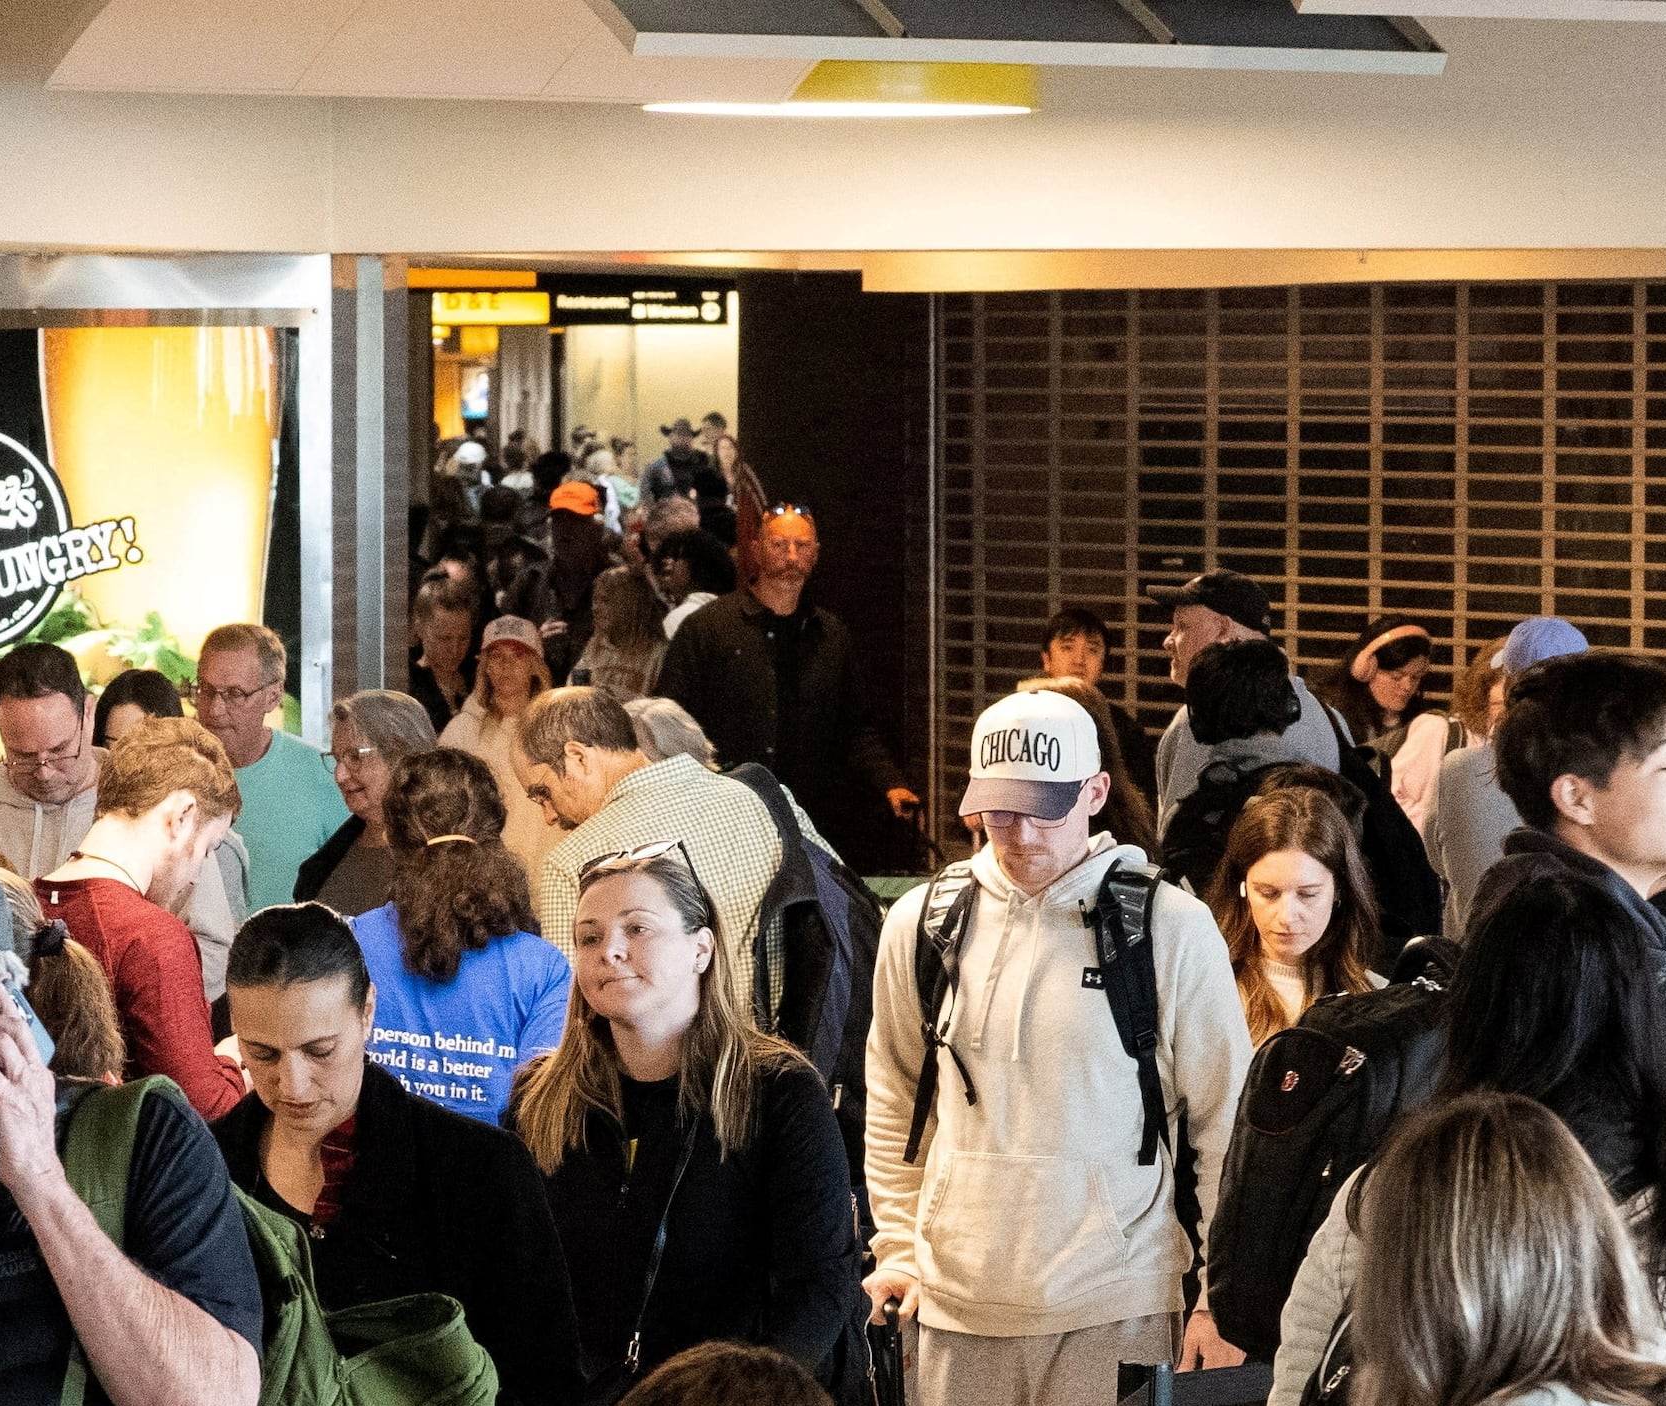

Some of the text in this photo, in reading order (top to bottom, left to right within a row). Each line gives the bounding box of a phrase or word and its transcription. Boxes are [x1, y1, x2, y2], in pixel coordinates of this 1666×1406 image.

[980, 728, 1061, 772] CHICAGO
[372, 1027, 431, 1048] person
[434, 1031, 495, 1056] behind
[411, 1053, 425, 1071] is
[428, 1060, 439, 1073] a
[442, 1056, 493, 1079] better
[414, 1080, 446, 1097] you
[450, 1082, 467, 1099] in
[471, 1084, 487, 1101] it.
